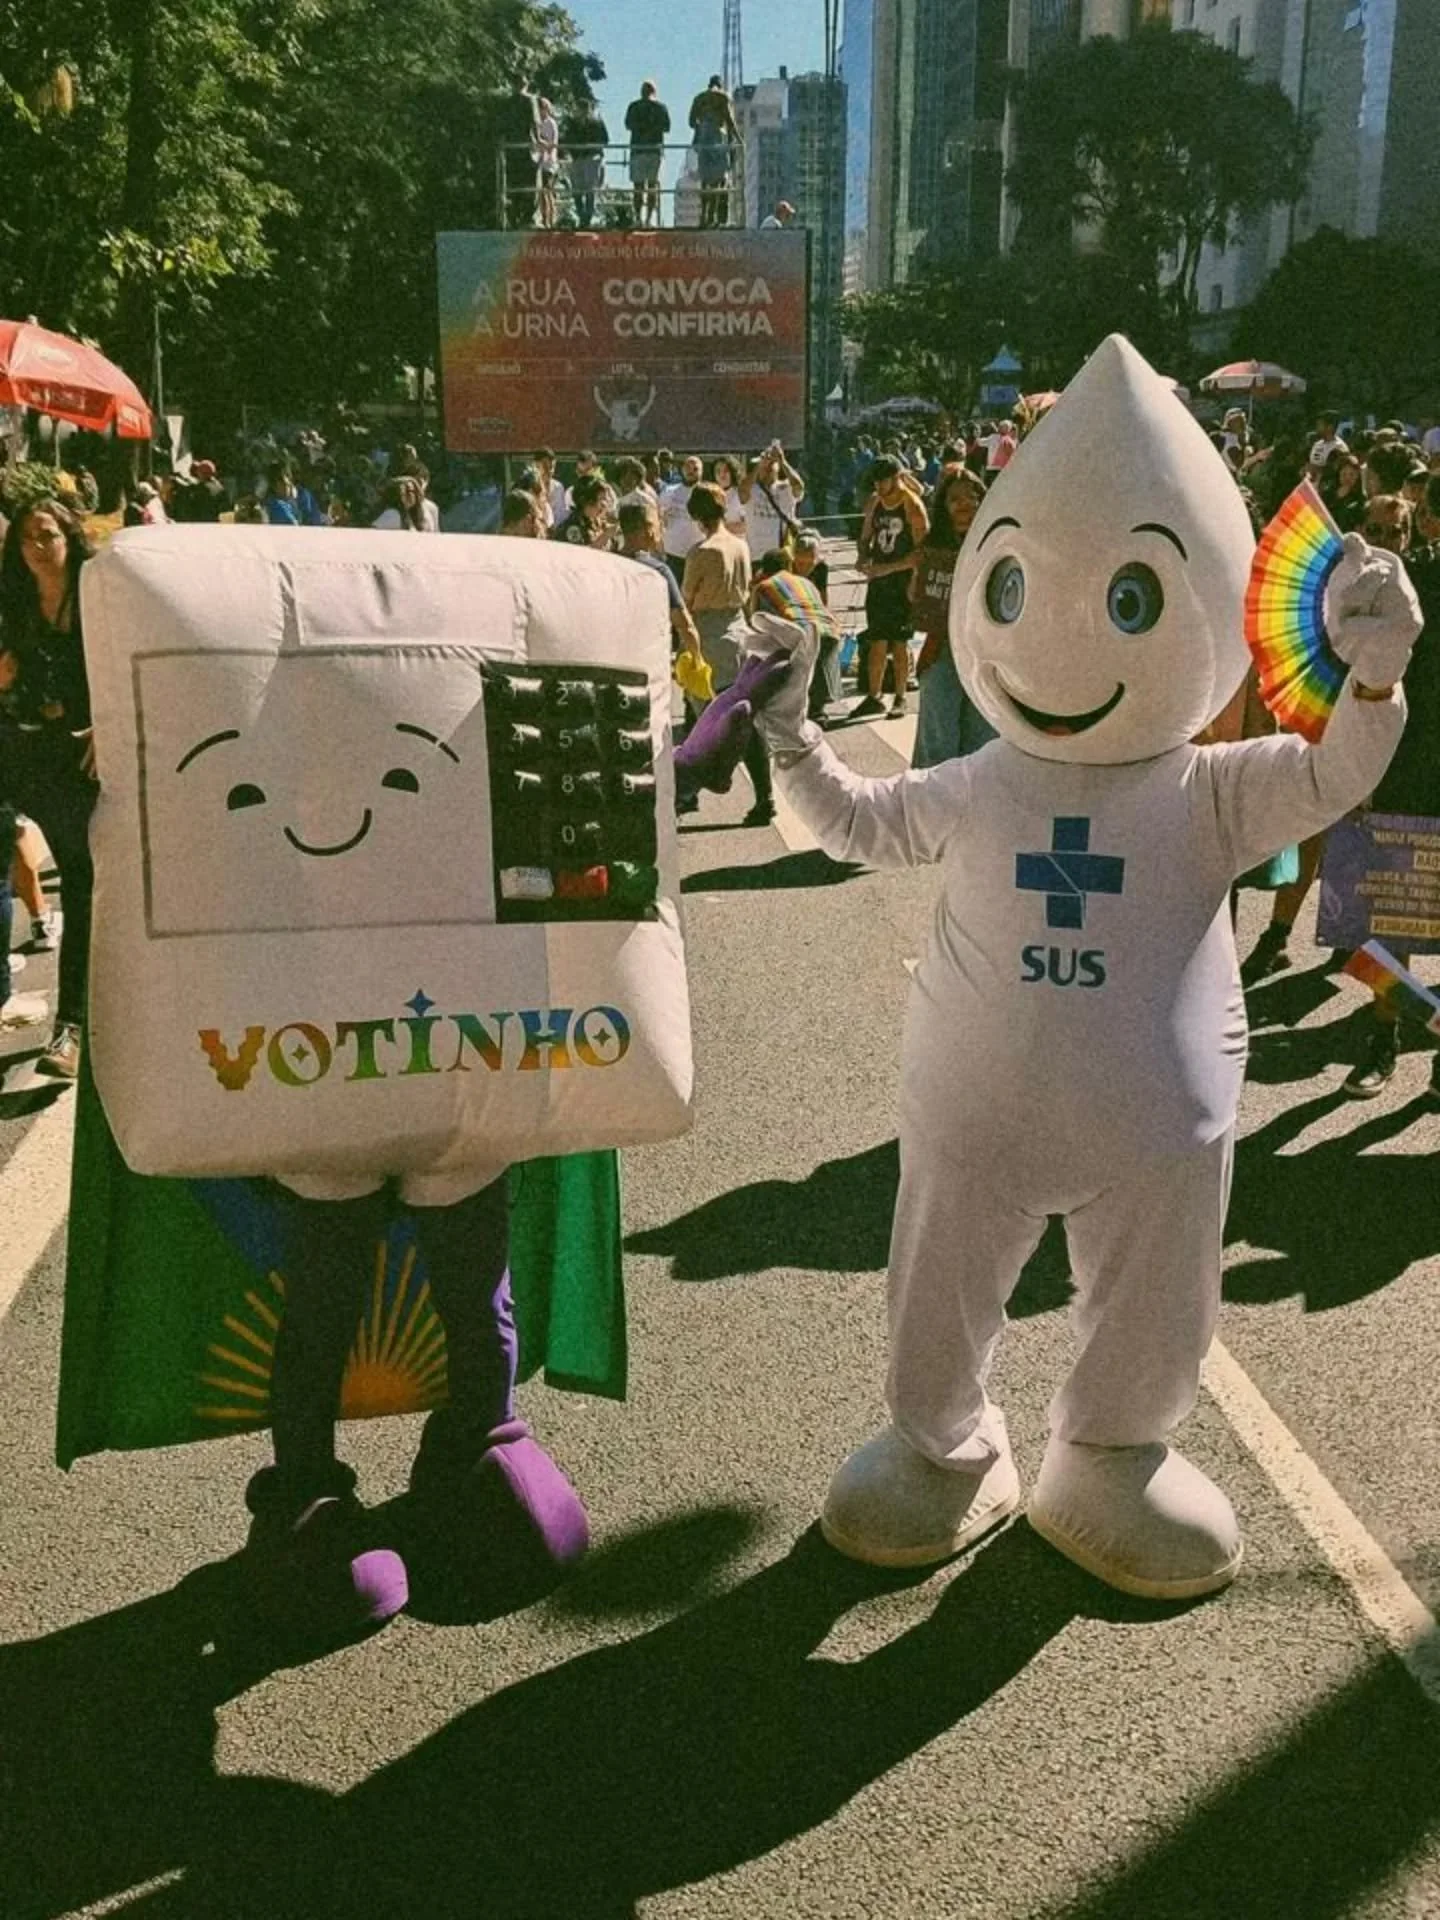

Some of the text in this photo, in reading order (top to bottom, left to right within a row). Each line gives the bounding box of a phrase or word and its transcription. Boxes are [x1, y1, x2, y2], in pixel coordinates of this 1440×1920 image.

[471, 277, 774, 306] A RUA CONVOCA
[471, 311, 775, 339] A URNA CONFIRMA
[556, 687, 569, 705] 2
[559, 729, 573, 749] 5
[619, 731, 633, 751] 6
[560, 774, 575, 794] 8
[623, 773, 635, 795] 9
[561, 825, 576, 844] 0
[1021, 945, 1106, 988] SUS
[198, 988, 631, 1091] VOTINHO
